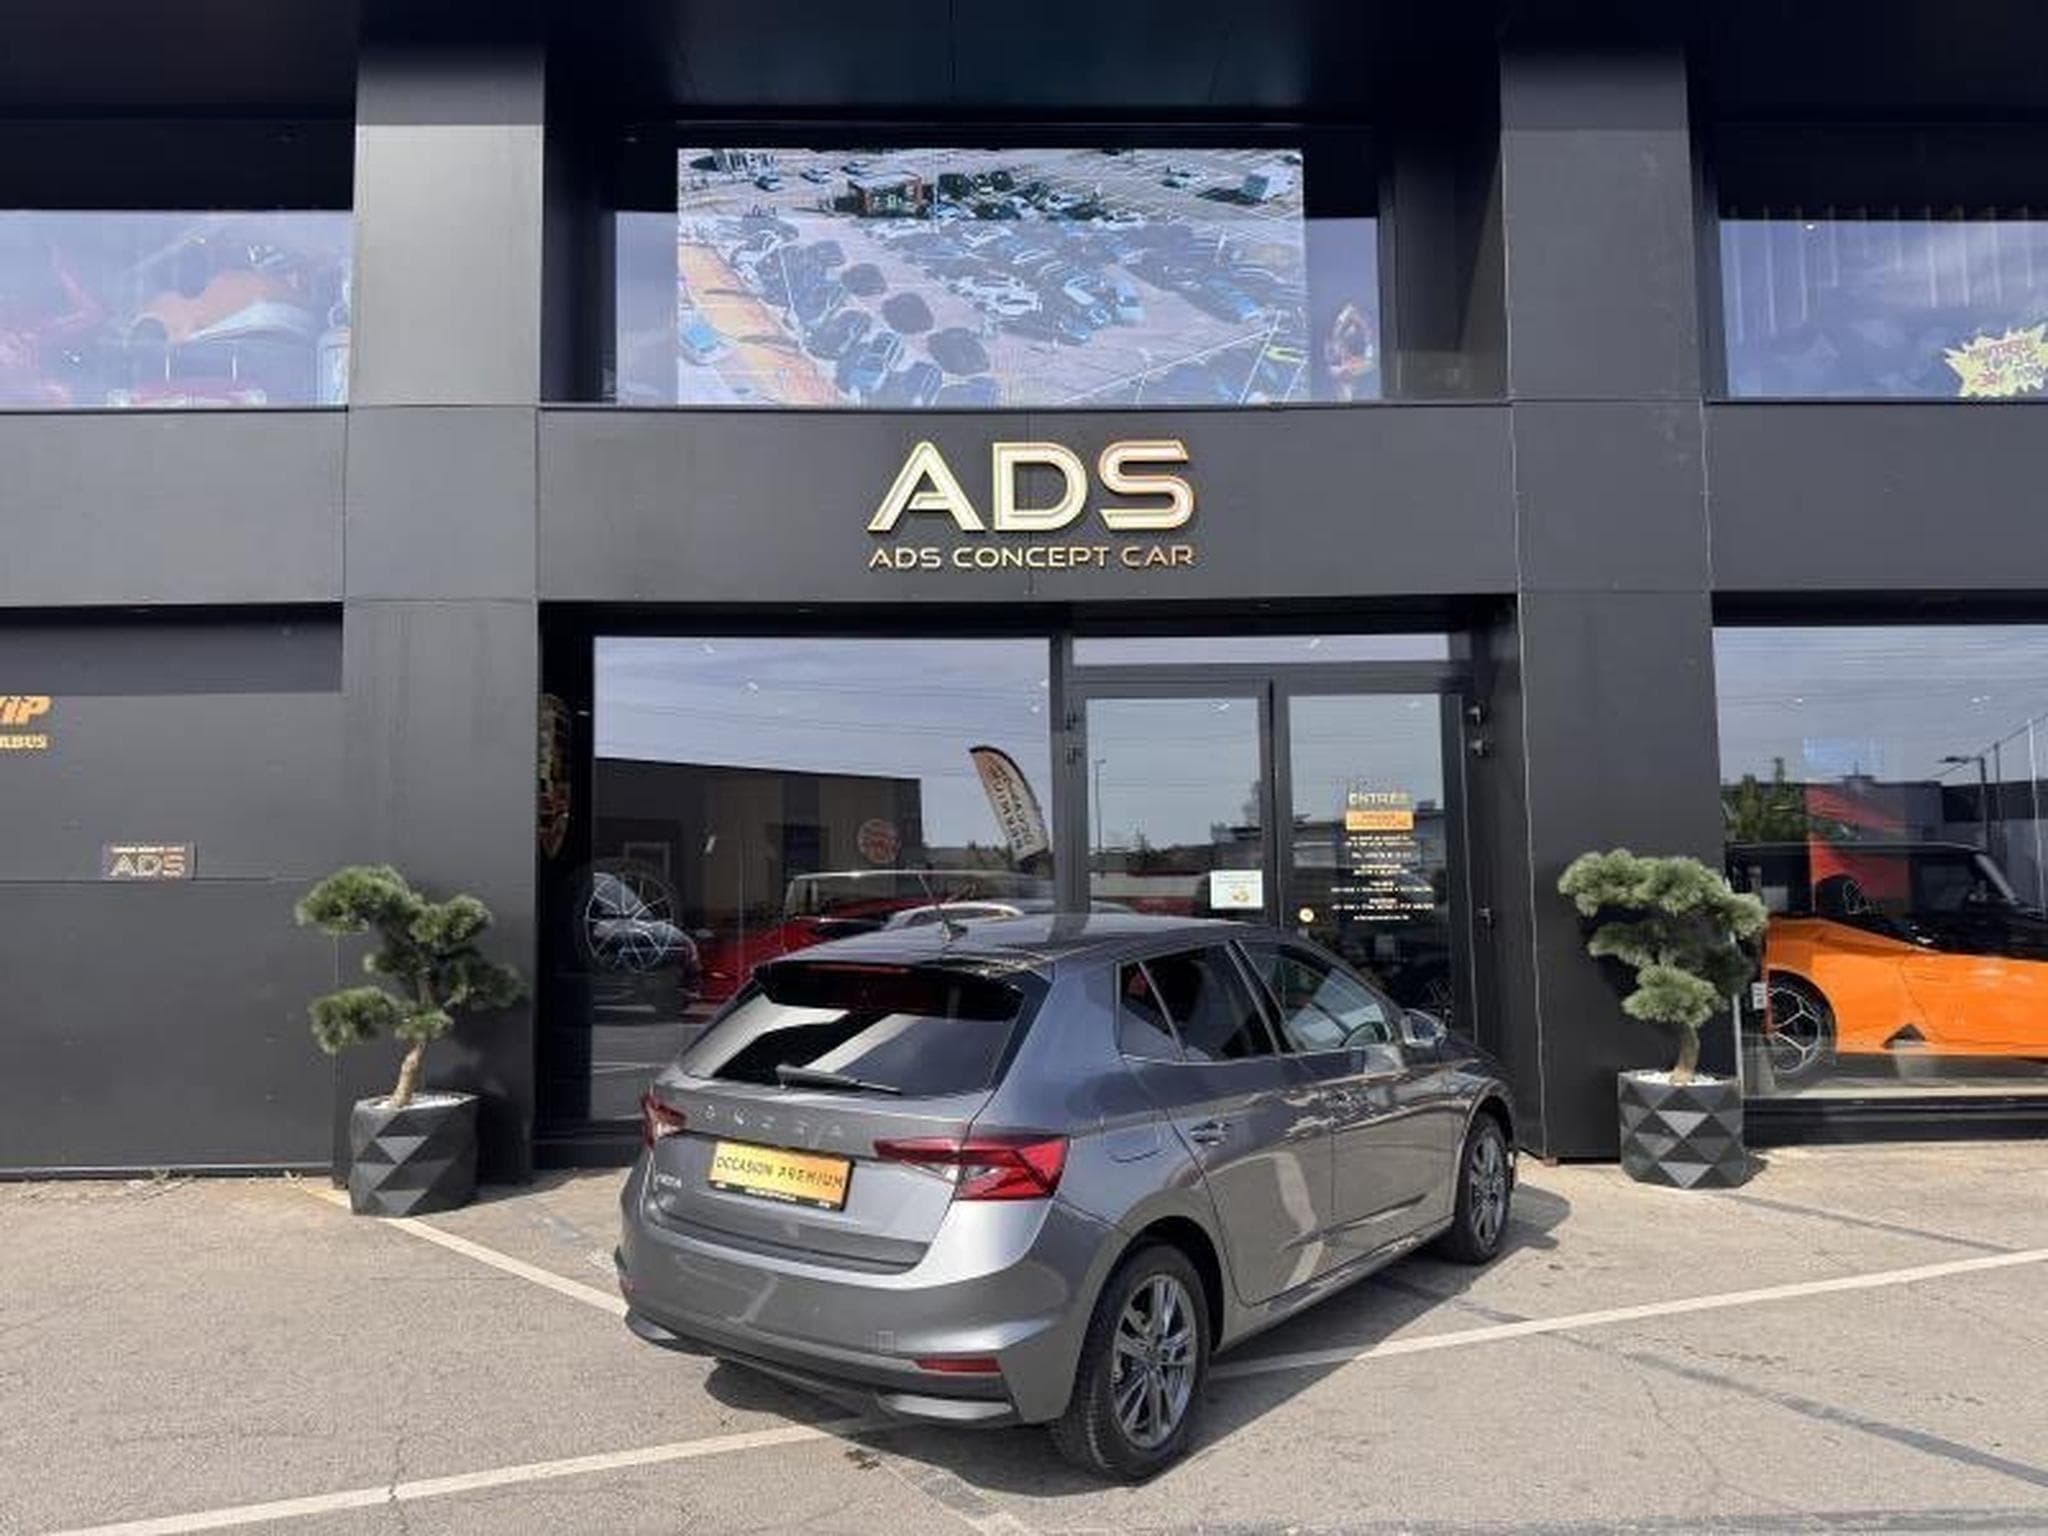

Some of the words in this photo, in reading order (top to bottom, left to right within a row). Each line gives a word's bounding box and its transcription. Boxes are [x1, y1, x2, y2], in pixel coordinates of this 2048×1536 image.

[867, 440, 1195, 531] ADS
[868, 548, 941, 569] ADS
[953, 547, 1109, 568] CONCEPT
[1120, 546, 1194, 567] CAR
[110, 853, 186, 877] ADS
[716, 1156, 773, 1176] OCCASION
[777, 1166, 843, 1189] PREMIUM
